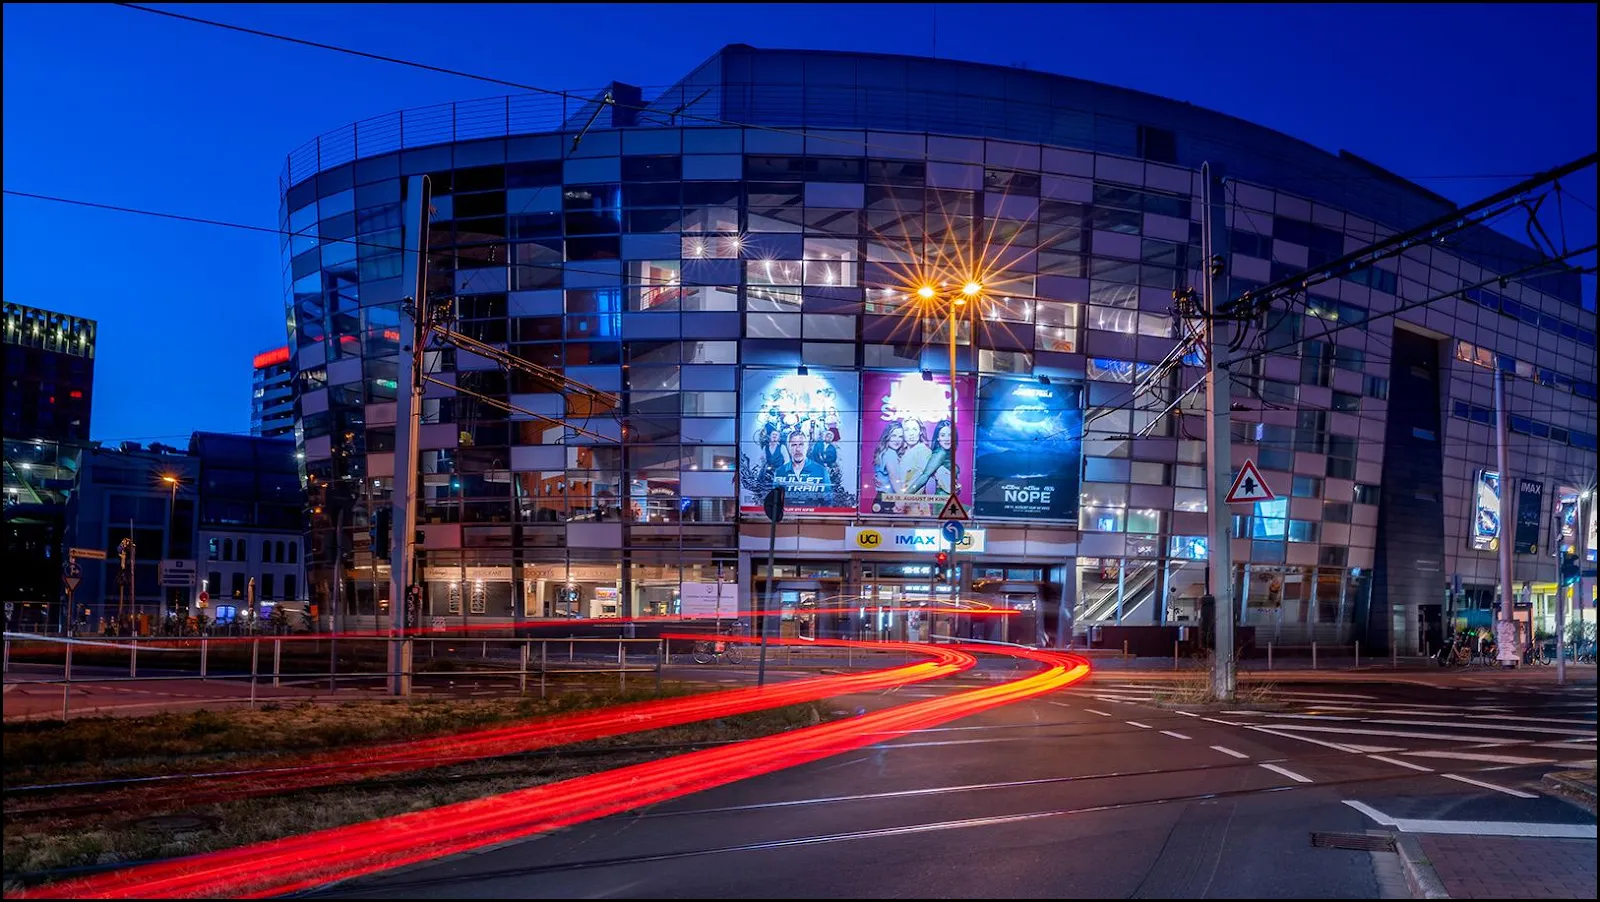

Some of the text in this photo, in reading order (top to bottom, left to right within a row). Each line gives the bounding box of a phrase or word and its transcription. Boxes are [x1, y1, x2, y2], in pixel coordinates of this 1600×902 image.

[774, 476, 823, 484] BULLET
[1521, 482, 1541, 495] IMAX
[1004, 490, 1051, 503] NOPE
[860, 534, 878, 544] UCI
[895, 535, 935, 545] IMAX
